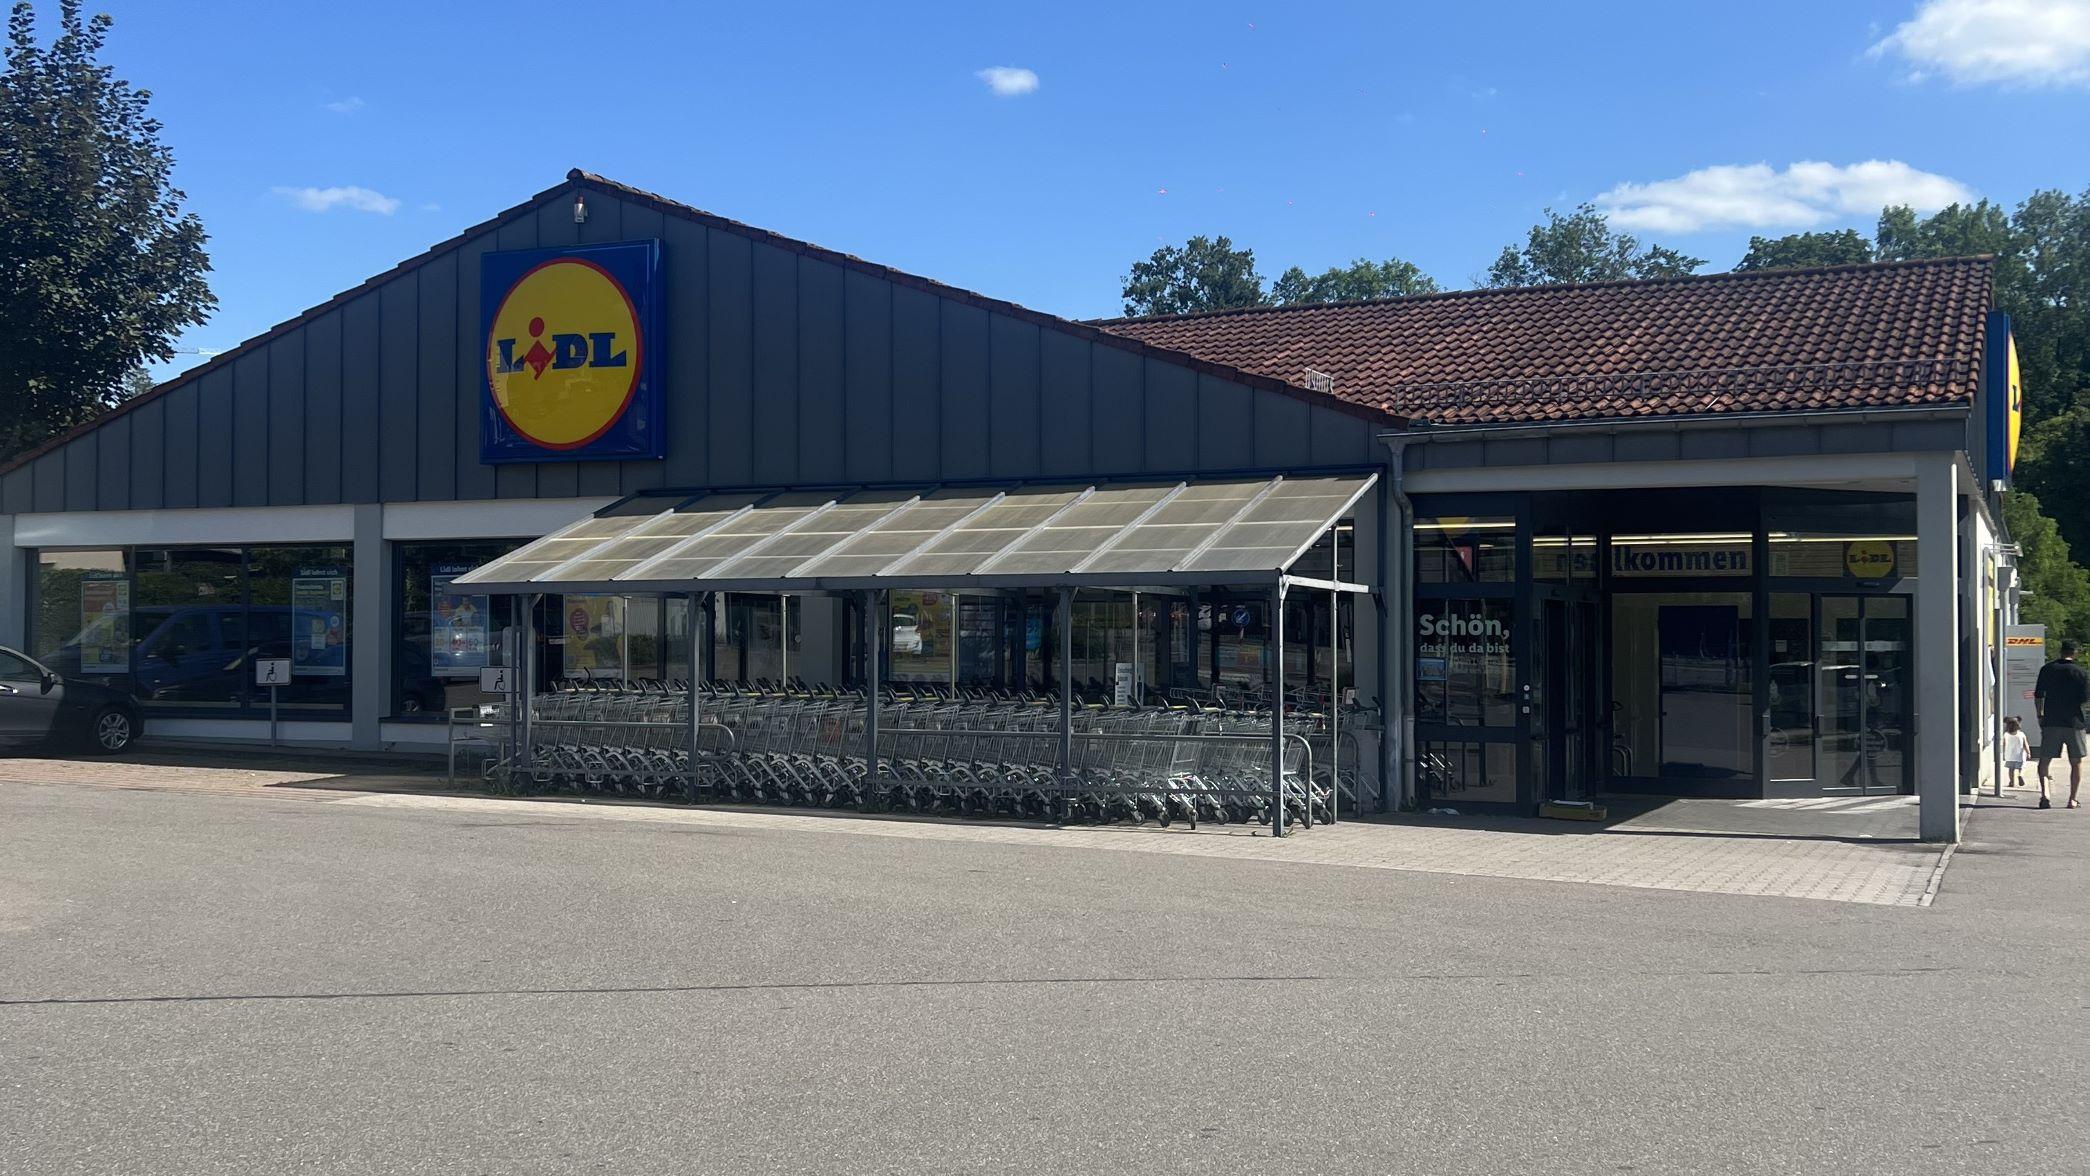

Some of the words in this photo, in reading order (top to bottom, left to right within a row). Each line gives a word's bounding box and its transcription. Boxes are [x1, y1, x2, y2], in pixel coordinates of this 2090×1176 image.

[1419, 613, 1510, 640] Schön,
[1449, 642, 1466, 653] du
[1468, 642, 1484, 653] da
[1486, 642, 1510, 653] bist
